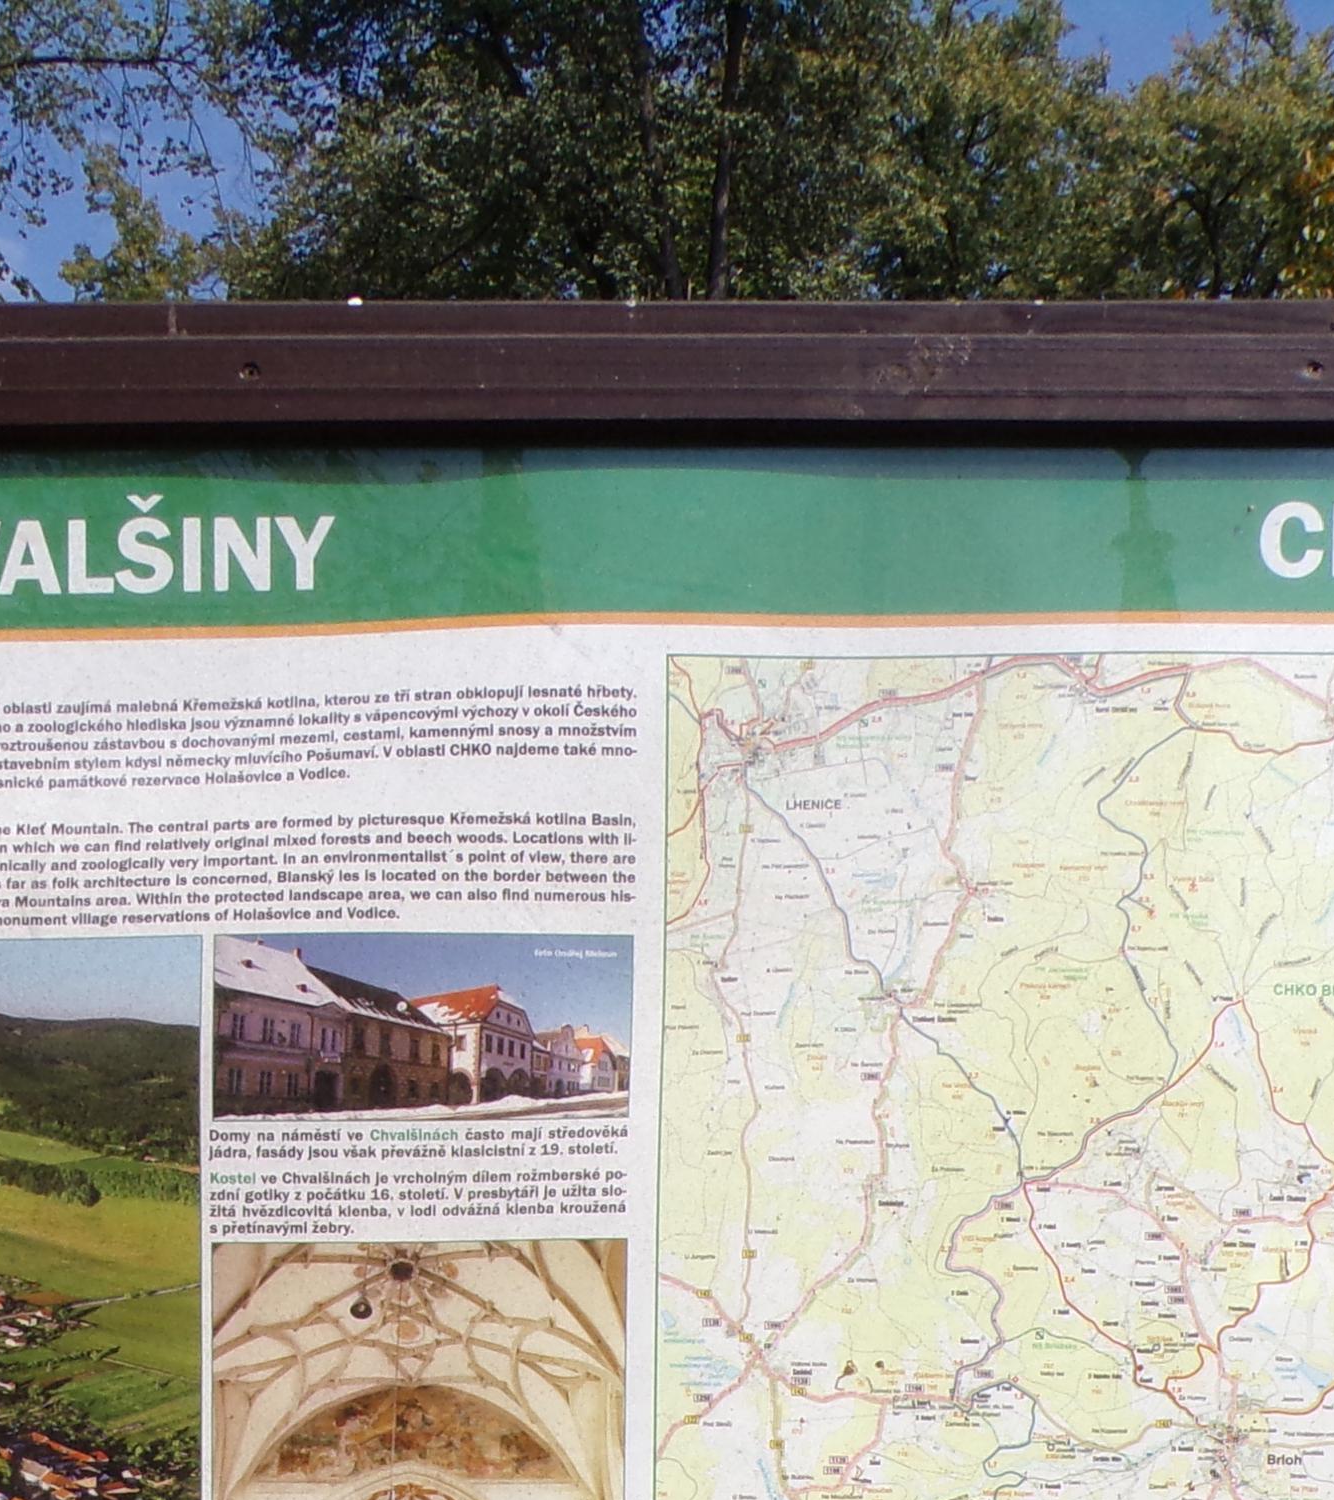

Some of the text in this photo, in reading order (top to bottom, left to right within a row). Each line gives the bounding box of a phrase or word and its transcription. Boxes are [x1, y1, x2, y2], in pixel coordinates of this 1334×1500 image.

[786, 799, 841, 810] LHENICE
[1273, 984, 1317, 996] CHKO
[208, 1124, 628, 1144] Domy na náměstí ve Chvalšinách často mají středověká
[207, 1142, 251, 1161] jádra,
[255, 1144, 304, 1161] fasády
[306, 1144, 338, 1161] jsou
[342, 1144, 376, 1158] však
[380, 1143, 446, 1160] převážně
[450, 1142, 525, 1157] klasicistní
[539, 1142, 563, 1156] 19.
[567, 1140, 618, 1155] století.
[209, 1167, 627, 1186] Kostel ve Chvalšinách je vrcholným dílem rožmberské po-
[208, 1187, 240, 1201] zdní
[243, 1188, 290, 1204] gotiky
[306, 1186, 365, 1203] počátku
[369, 1184, 394, 1200] 16.
[397, 1183, 449, 1200] století.
[467, 1184, 539, 1202] presbytáři
[542, 1184, 556, 1200] je
[561, 1183, 596, 1202] užita
[600, 1183, 627, 1202] slo-
[208, 1203, 236, 1217] žitá
[241, 1200, 332, 1217] hvězdicovitá
[337, 1204, 391, 1218] klenba,
[409, 1203, 436, 1217] lodi
[441, 1199, 500, 1216] odvážná
[505, 1199, 554, 1215] klenba
[559, 1199, 626, 1214] kroužená
[221, 1220, 307, 1236] přetínavými
[311, 1220, 354, 1236] žebry.
[1267, 1454, 1301, 1465] Brloh
